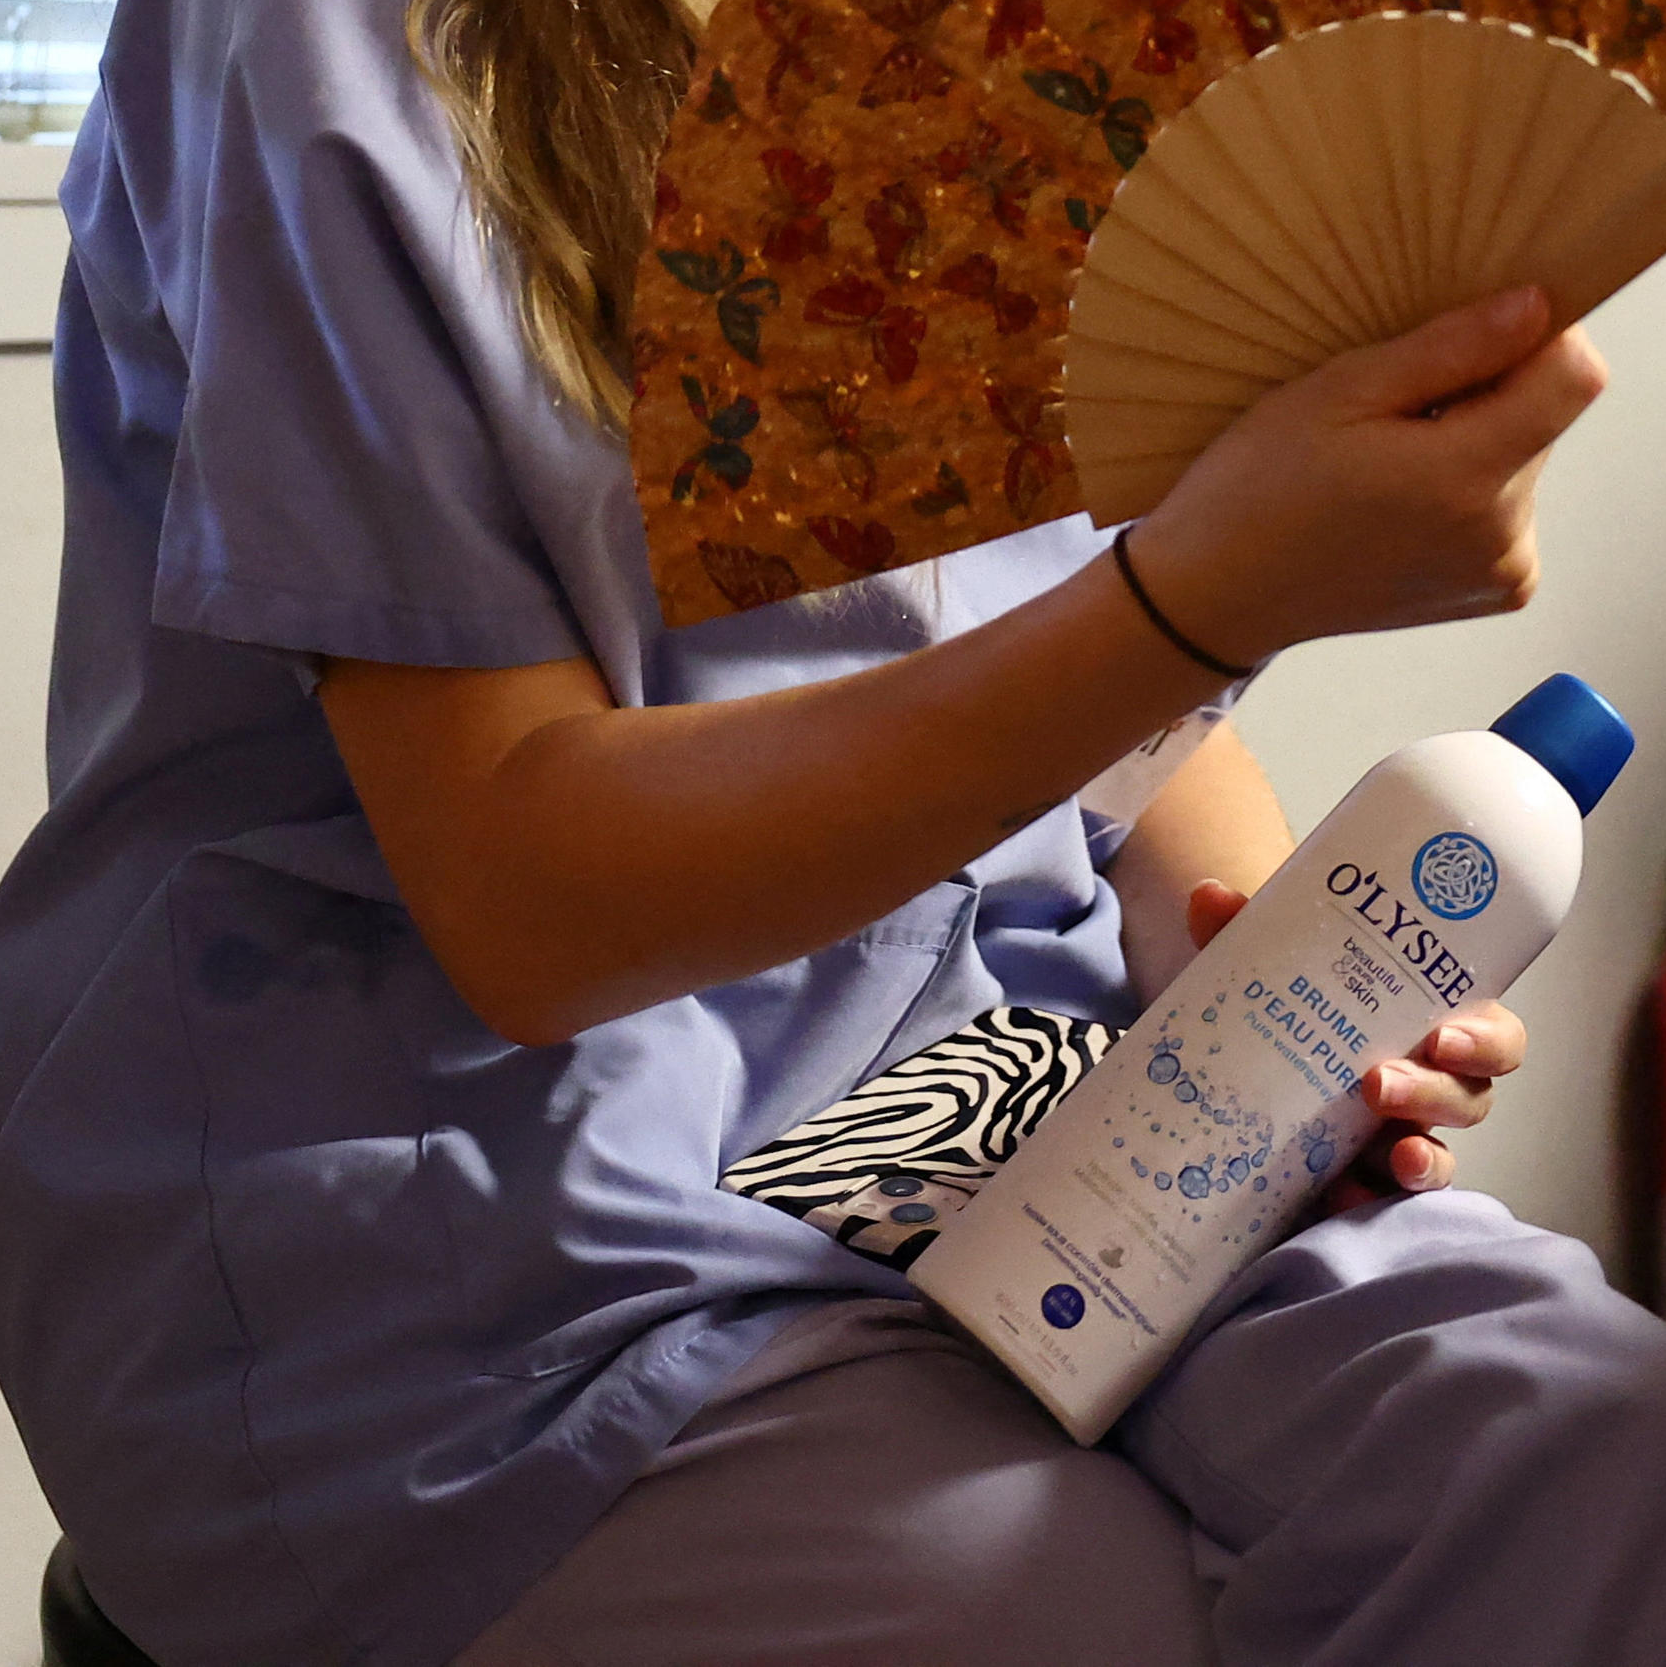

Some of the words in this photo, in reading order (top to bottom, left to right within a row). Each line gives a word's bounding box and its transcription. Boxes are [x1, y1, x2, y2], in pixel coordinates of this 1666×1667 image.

[1326, 863, 1475, 1009] O'LYSEE
[1343, 937, 1404, 996] beautiful
[1243, 980, 1315, 1044] D'EAU
[1288, 974, 1370, 1055] BRUME
[1344, 976, 1380, 1014] skin
